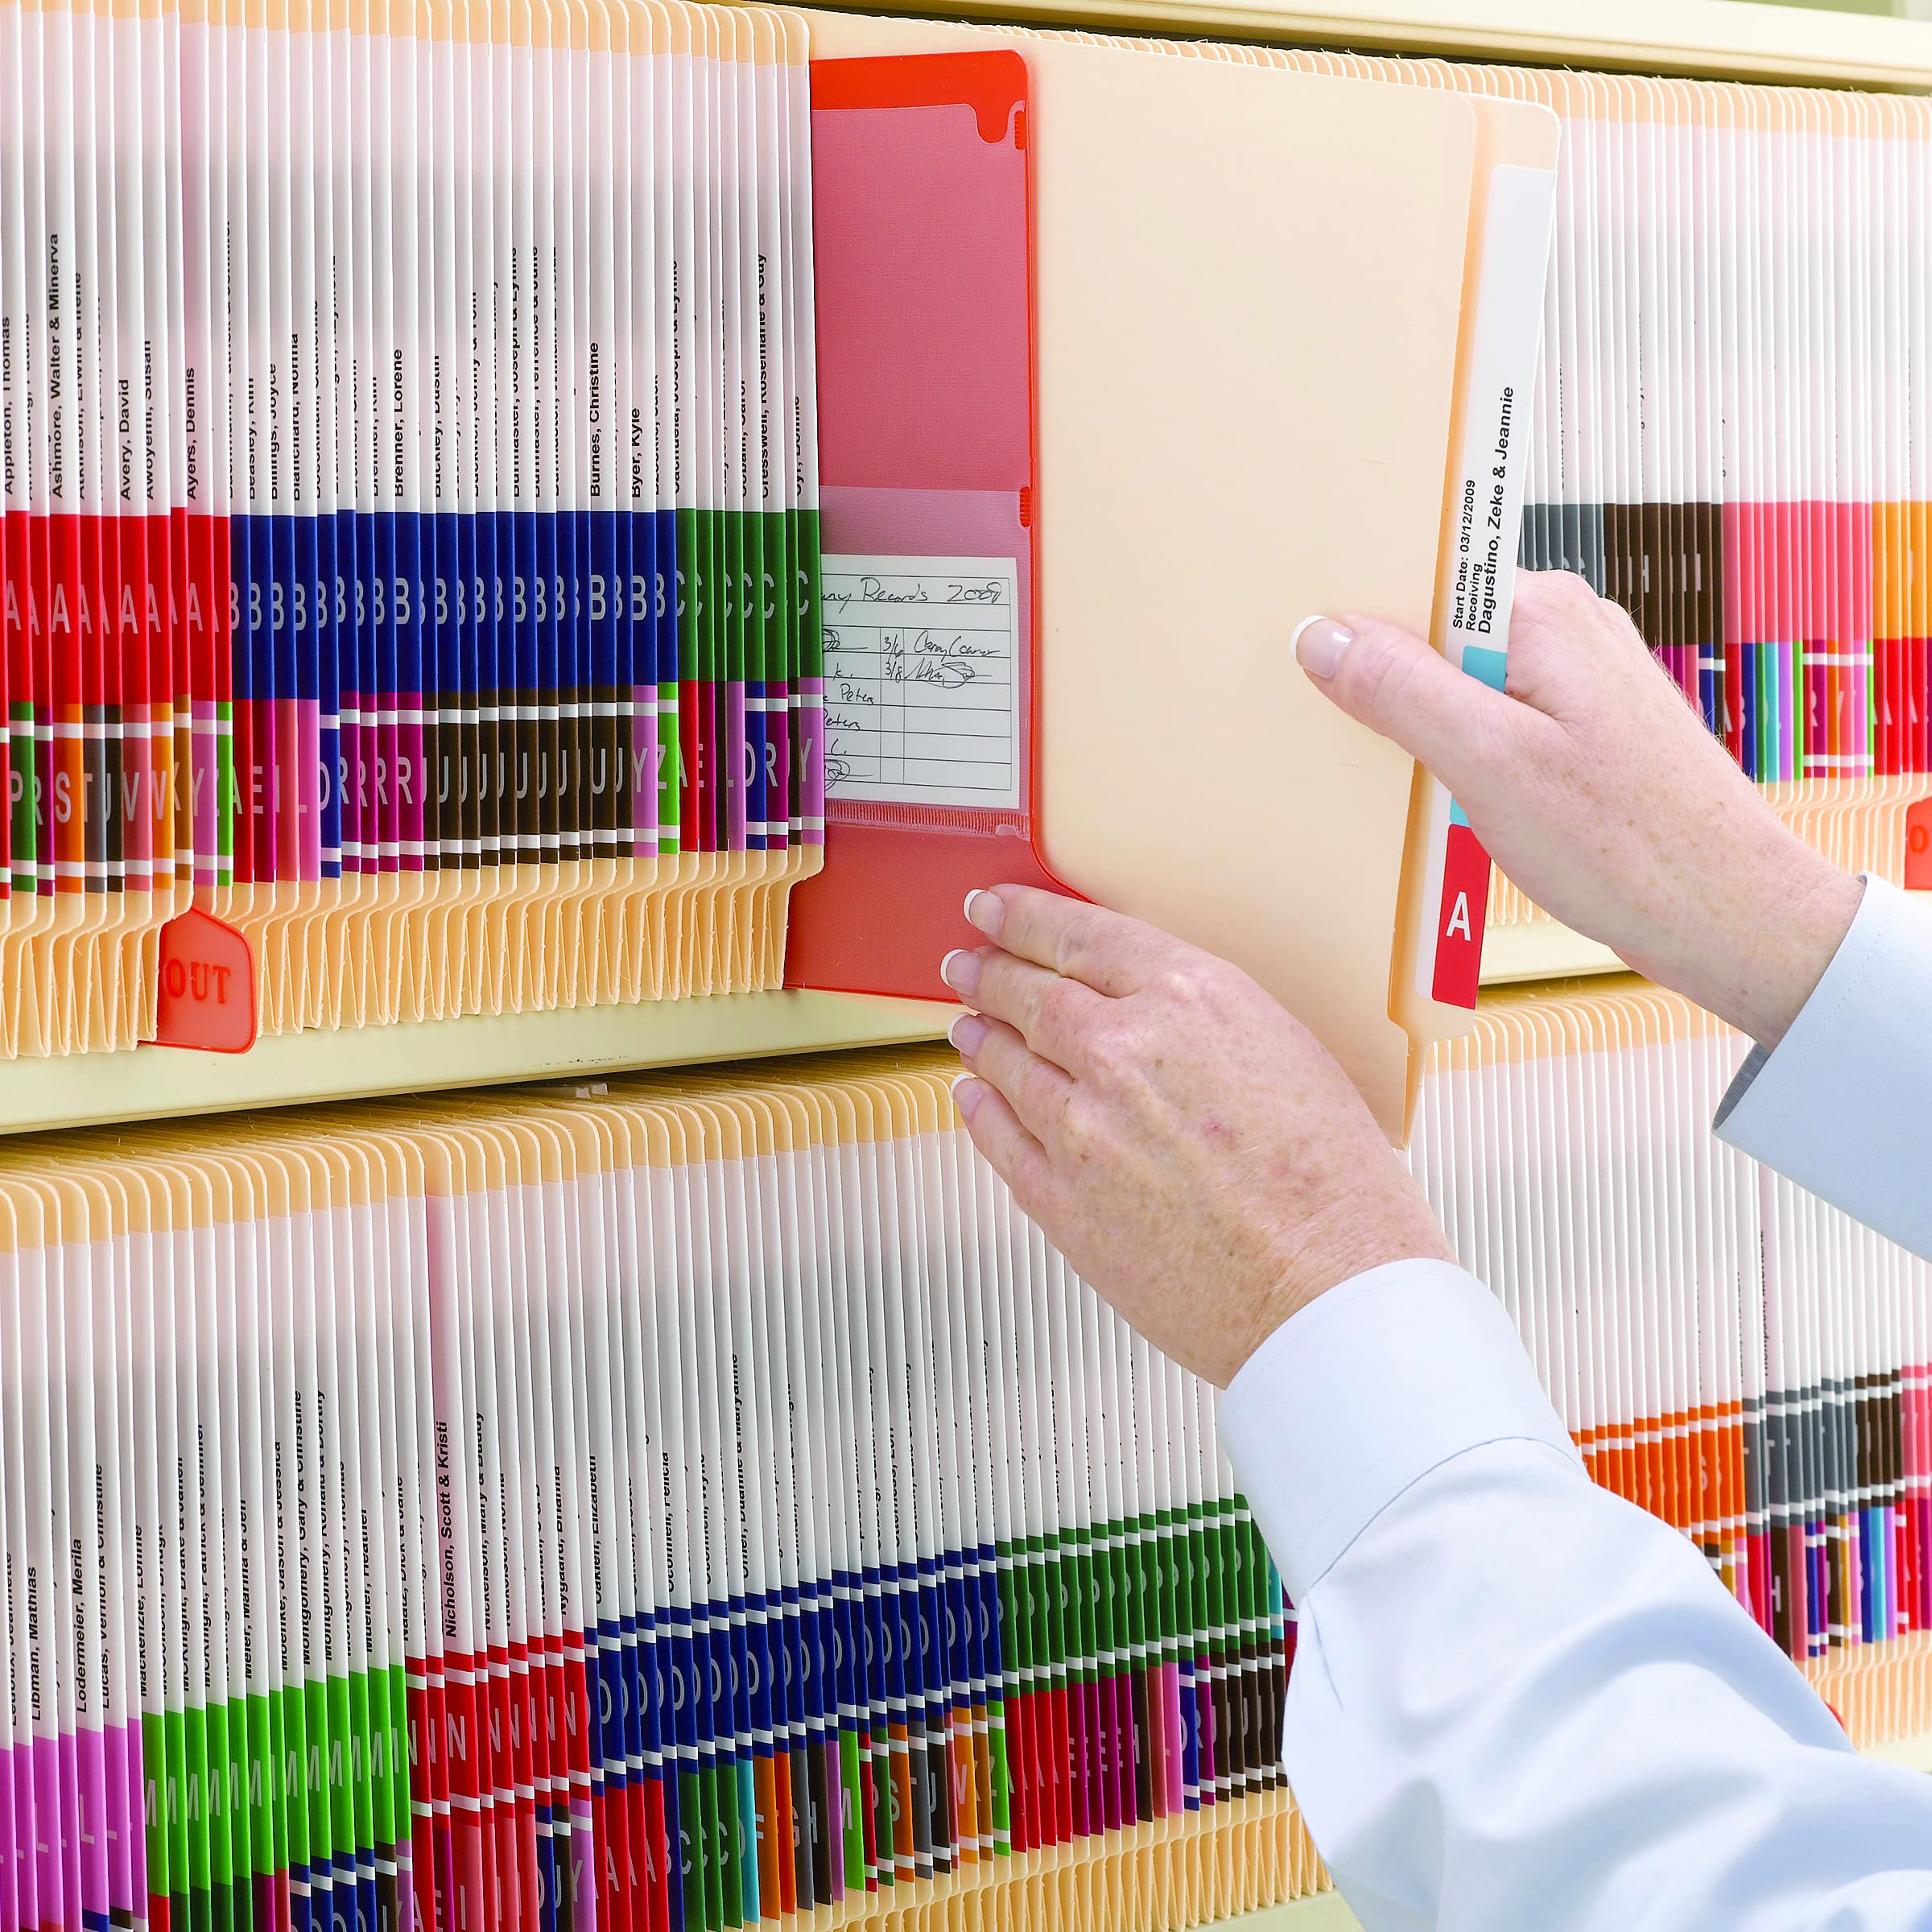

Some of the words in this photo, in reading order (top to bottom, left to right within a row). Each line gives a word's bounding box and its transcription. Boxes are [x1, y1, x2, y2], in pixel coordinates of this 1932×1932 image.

[49, 234, 58, 310] Minerva
[50, 317, 59, 330] &
[51, 336, 60, 398] Walter
[394, 349, 402, 412] Lorene
[590, 343, 599, 423] Christine
[119, 380, 129, 432] David
[187, 368, 195, 432] Dennis
[1495, 386, 1514, 460] Jeannie
[50, 406, 62, 497] Ashmore,
[121, 440, 132, 500] Avery,
[188, 440, 198, 500] Ayers,
[395, 419, 404, 496] Brenner,
[591, 429, 601, 497] Burnes,
[1492, 465, 1506, 478] &
[1459, 480, 1476, 552] 03/12/2009
[1488, 484, 1504, 530] Zeke
[591, 575, 605, 620] B
[633, 576, 647, 620] B
[861, 577, 928, 603] Records
[1455, 556, 1468, 592] Date:
[1466, 564, 1483, 631] Receiving
[1478, 534, 1501, 634] Dagustino,
[52, 583, 71, 634] A
[121, 584, 138, 634] A
[396, 578, 409, 625] B
[1452, 597, 1463, 629] Start
[398, 757, 411, 803] R
[592, 748, 606, 795] U
[633, 747, 647, 793] Y
[766, 740, 778, 786] R
[800, 738, 813, 784] Y
[10, 773, 23, 819] P
[55, 772, 71, 823] S
[123, 773, 139, 821] V
[254, 767, 263, 813] E
[1447, 891, 1473, 941] A
[165, 958, 232, 1004] OUT
[435, 1422, 448, 1468] Kristi
[436, 1473, 449, 1487] &
[439, 1492, 452, 1539] Scott
[71, 1539, 82, 1595] Merila
[442, 1546, 456, 1637] Nicholson,
[28, 1567, 38, 1640] Mathias
[74, 1603, 86, 1713] Lodermeier,
[31, 1647, 40, 1720] Libman,
[448, 1714, 465, 1761] N
[80, 1794, 94, 1844] L
[460, 1885, 464, 1930] I
